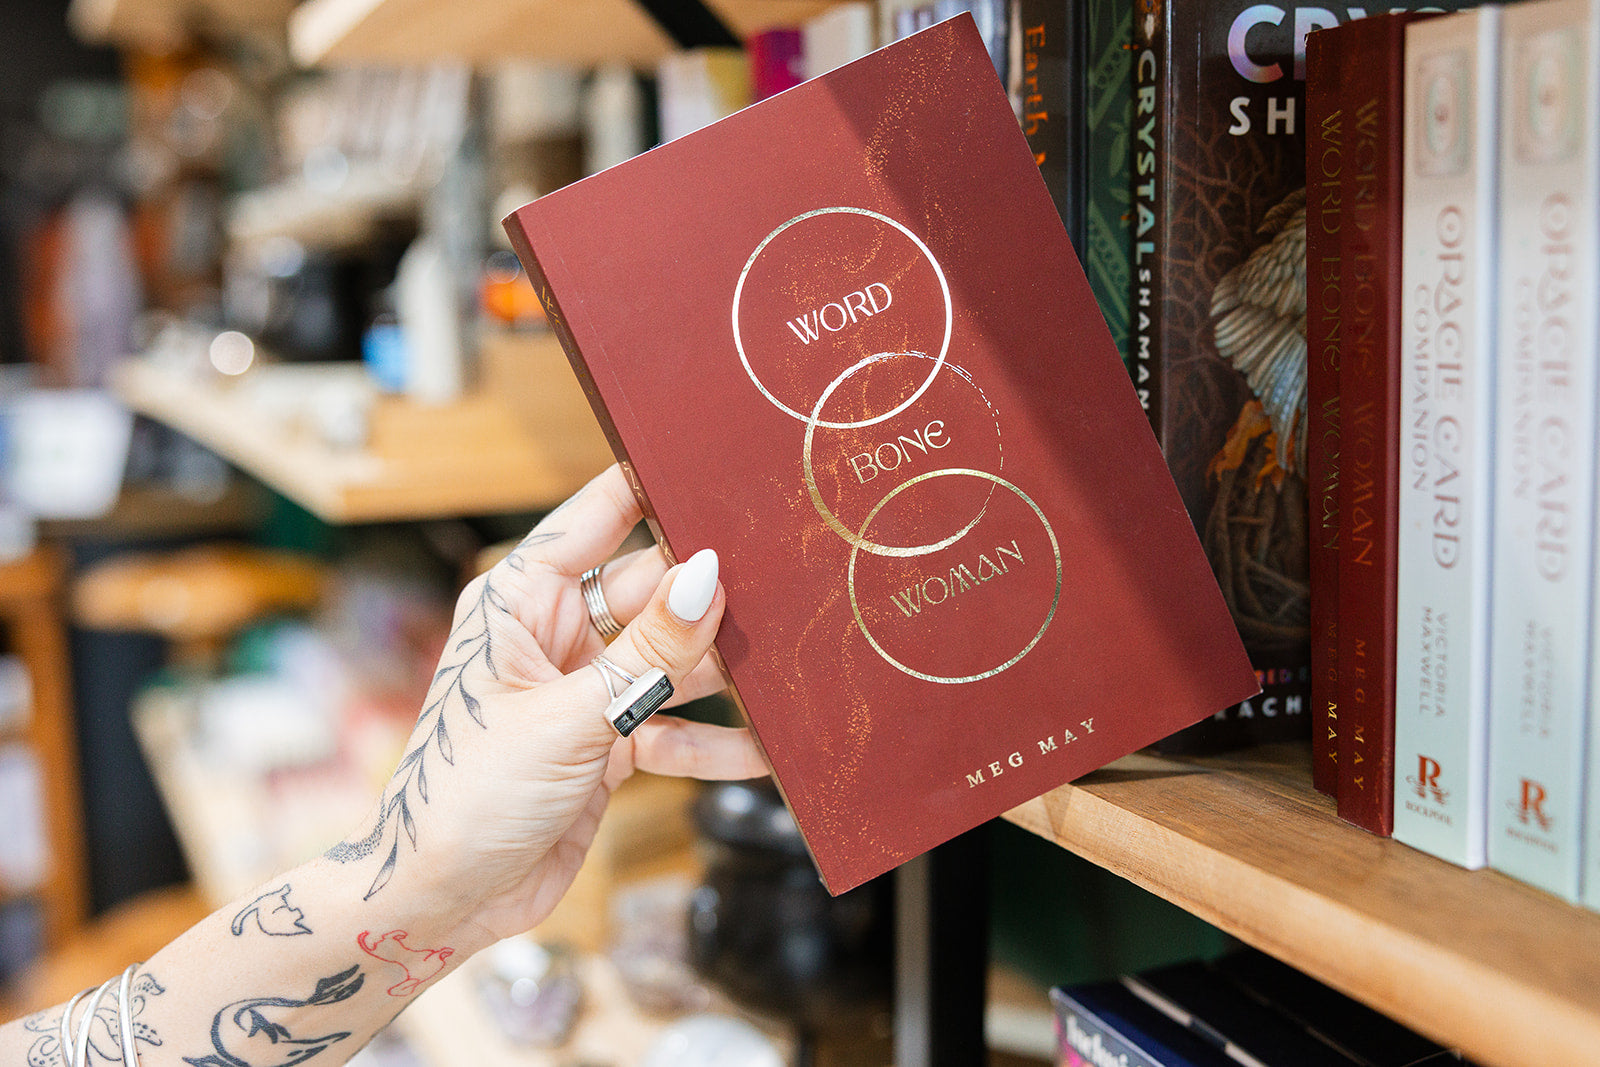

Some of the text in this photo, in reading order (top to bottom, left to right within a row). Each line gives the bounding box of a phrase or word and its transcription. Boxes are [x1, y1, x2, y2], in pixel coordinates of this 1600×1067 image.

[1025, 23, 1048, 136] Earth
[1354, 99, 1378, 231] WORD
[1136, 50, 1156, 410] CRYSTAL SHAMAN
[786, 282, 893, 346] WORD
[1321, 110, 1342, 550] WORD BONE WOMAN
[1412, 283, 1430, 493] COMPANION
[850, 419, 952, 485] BONE
[1432, 415, 1461, 569] CARD
[889, 539, 1026, 618] WOMAN
[965, 717, 1096, 788] MEG MAY
[1327, 701, 1338, 764] MAY
[1353, 638, 1367, 790] MEG MAY
